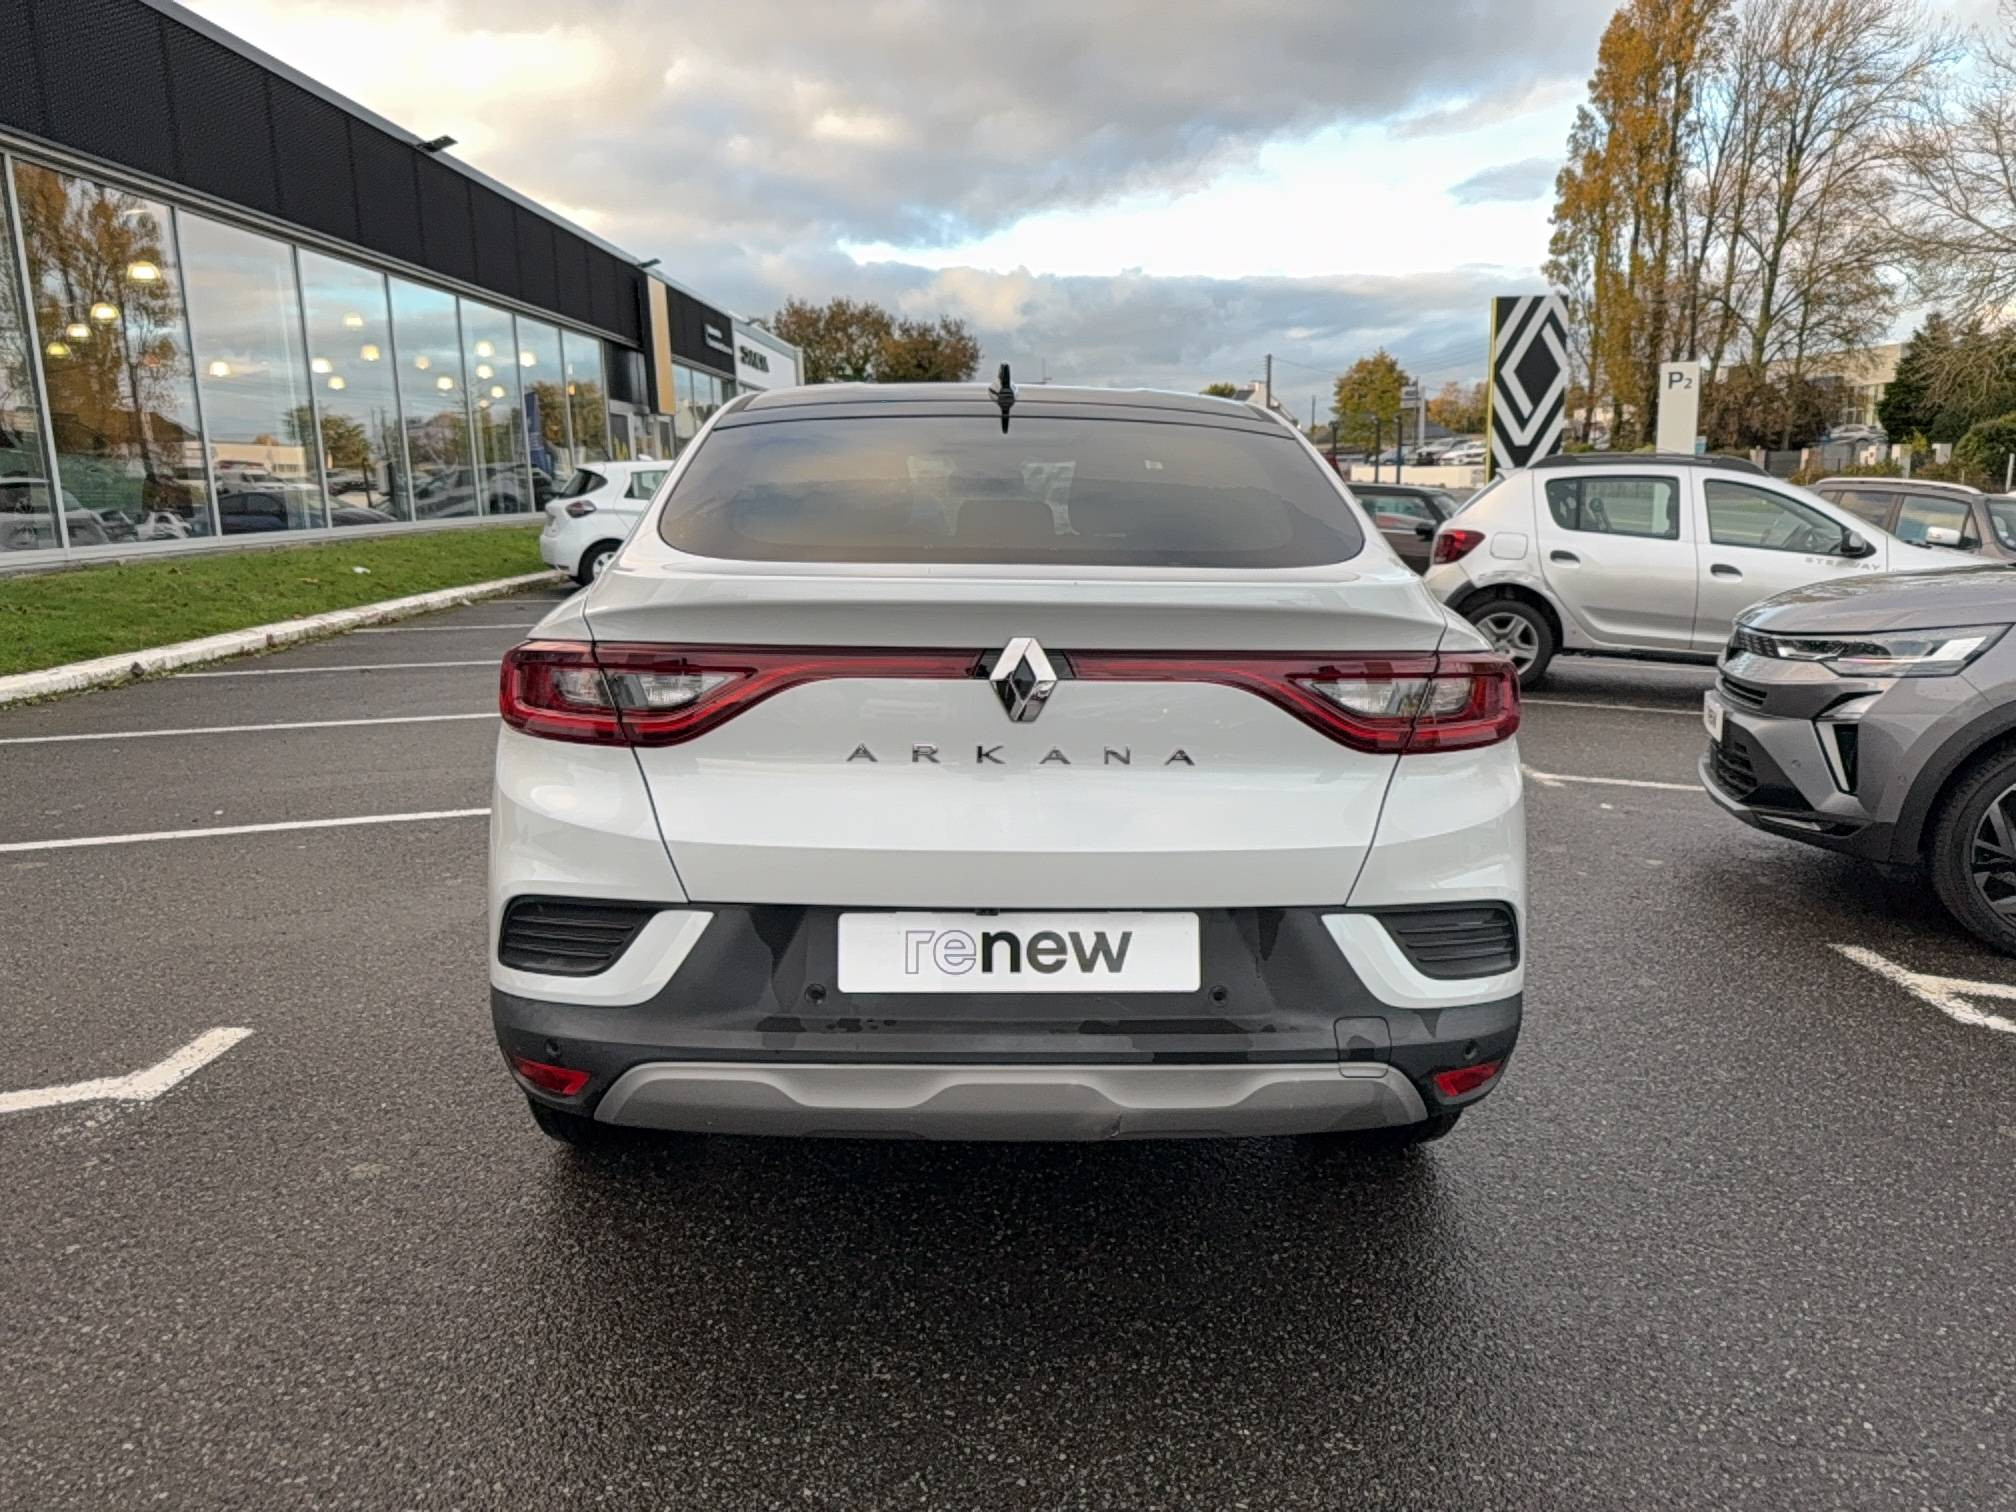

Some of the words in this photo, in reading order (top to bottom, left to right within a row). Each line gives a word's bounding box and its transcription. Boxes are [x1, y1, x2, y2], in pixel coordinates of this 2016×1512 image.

[1668, 371, 1692, 389] P2
[846, 743, 1195, 766] ARKANA
[905, 930, 1133, 975] renew
